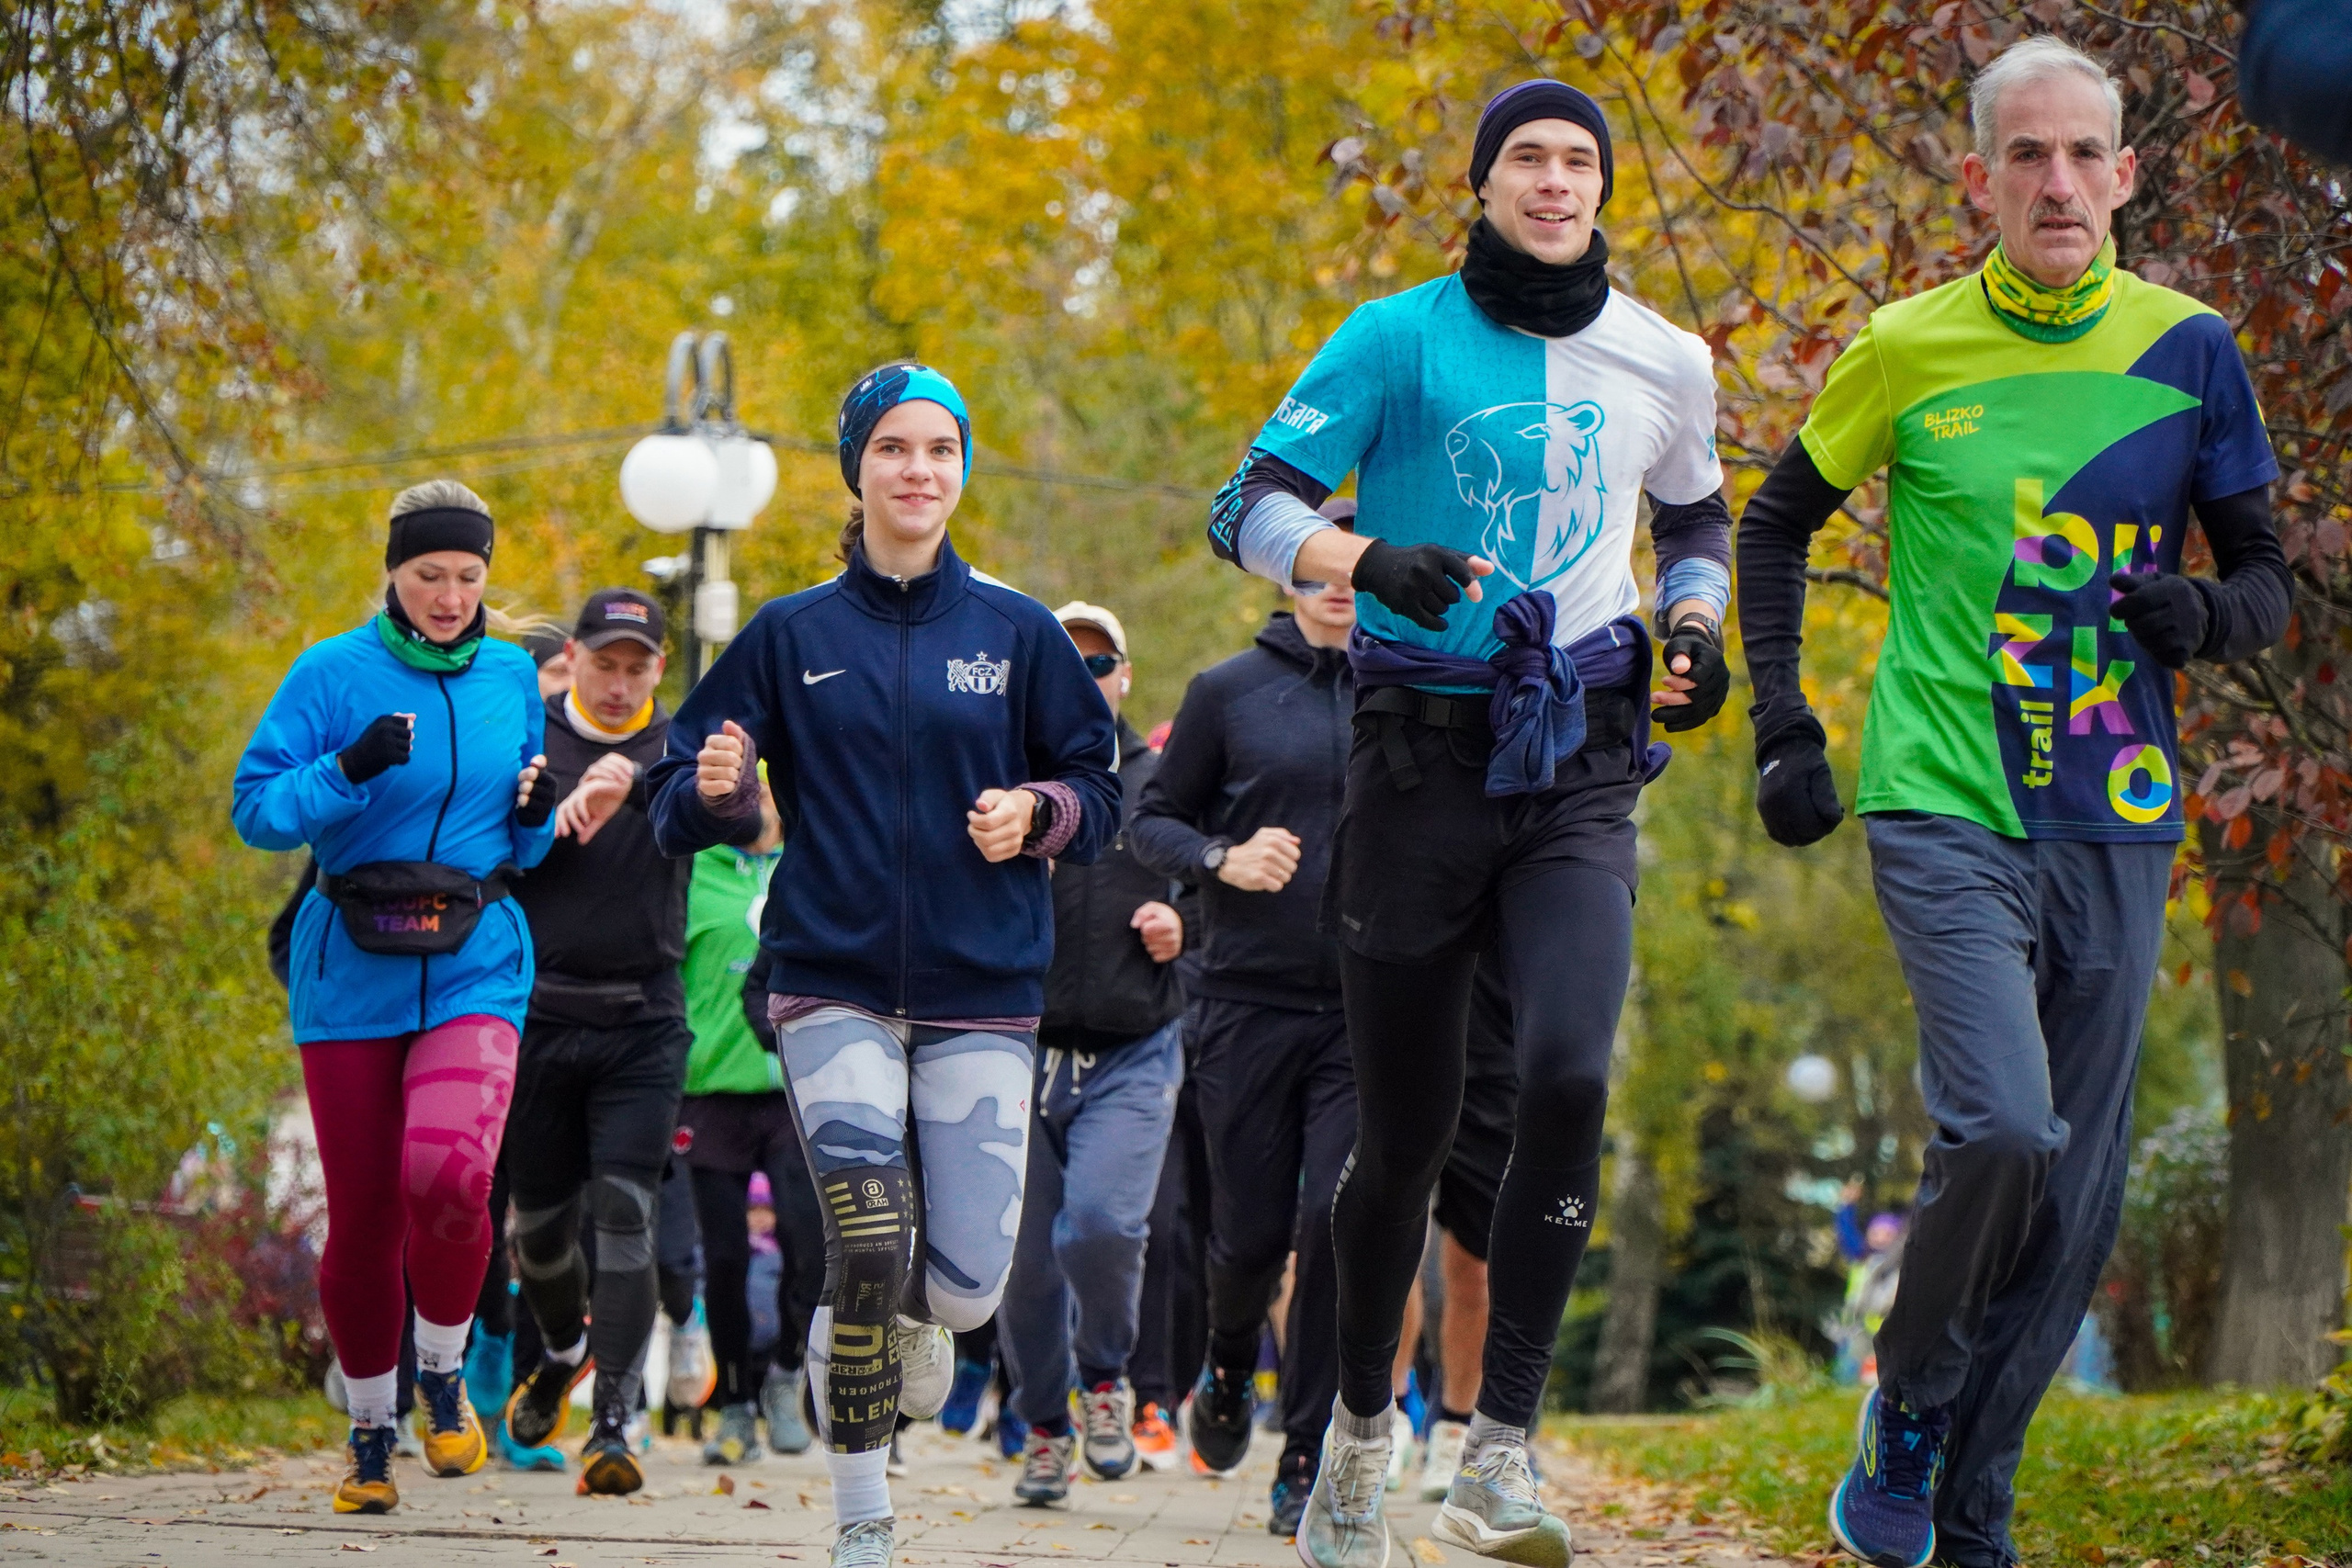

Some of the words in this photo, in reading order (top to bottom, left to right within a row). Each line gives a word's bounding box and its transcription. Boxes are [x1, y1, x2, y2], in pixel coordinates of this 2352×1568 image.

[1924, 404, 1984, 428] BLIZKO
[1930, 421, 1981, 441] TRAIL
[972, 667, 993, 676] FCZ
[2019, 700, 2054, 790] trail
[373, 914, 440, 933] TEAM
[1544, 1214, 1588, 1227] KELME
